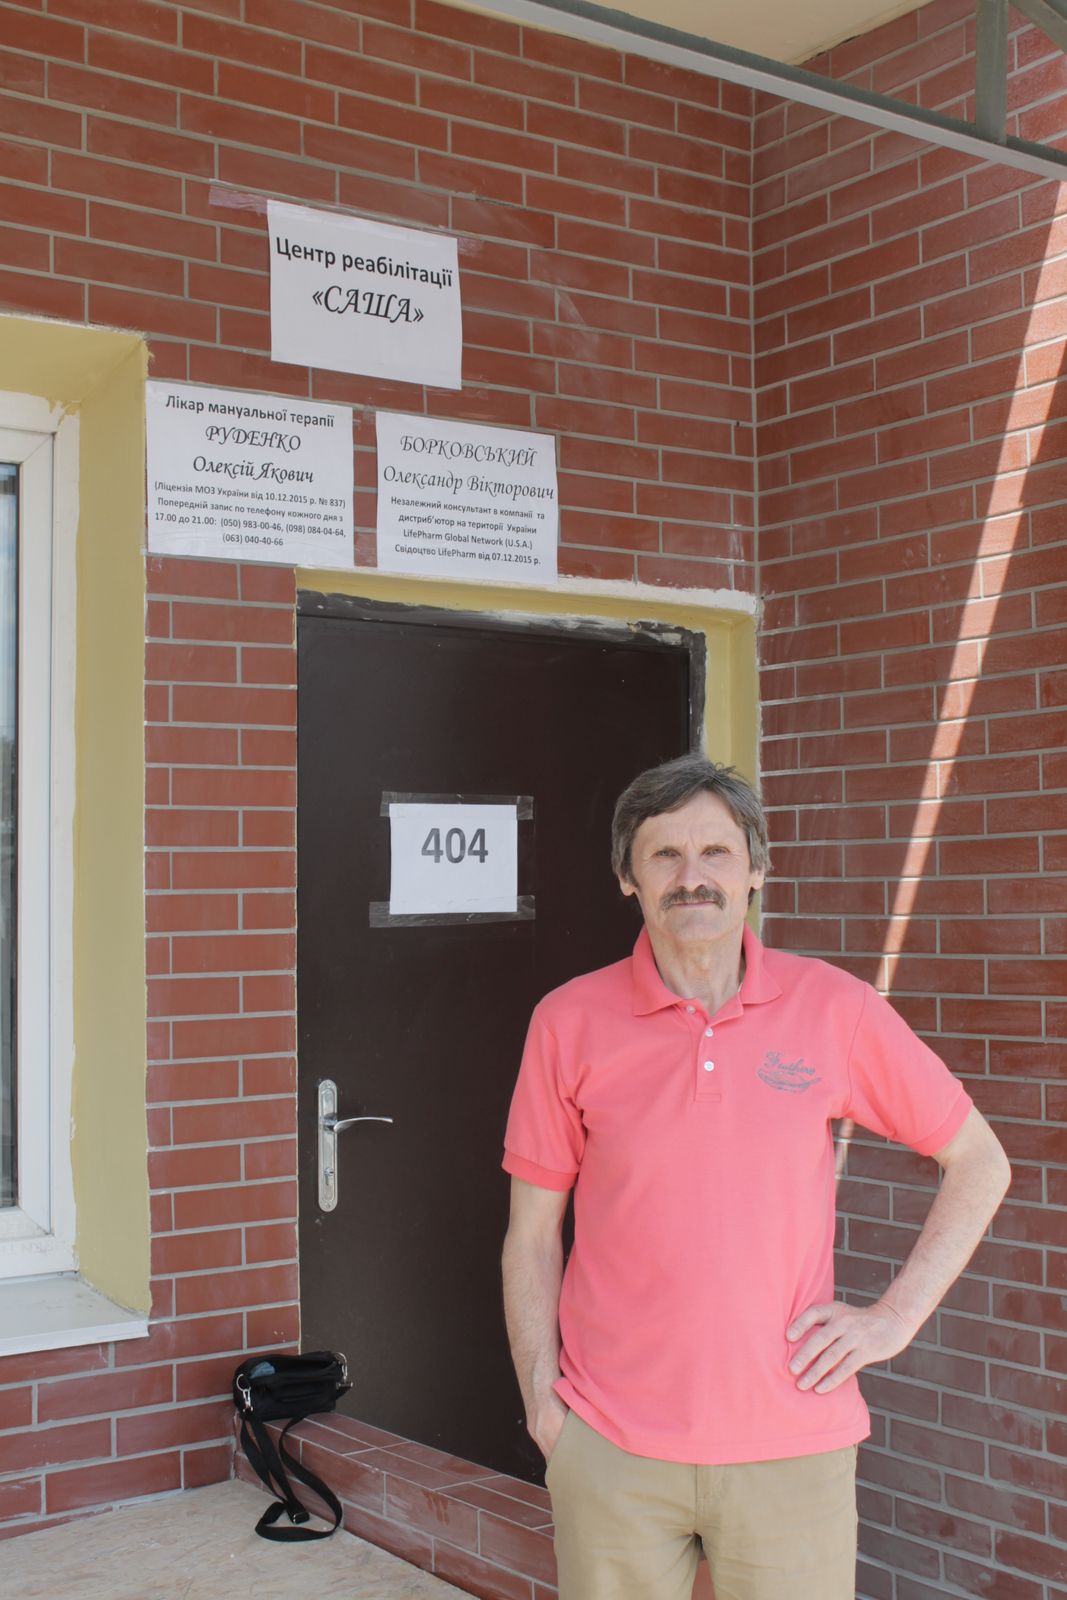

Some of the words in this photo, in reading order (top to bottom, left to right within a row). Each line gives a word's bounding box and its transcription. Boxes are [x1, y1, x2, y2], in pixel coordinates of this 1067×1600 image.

[276, 237, 336, 268] Центр
[342, 252, 452, 289] реабілітації
[312, 285, 424, 323] «САША»
[165, 395, 204, 413] Лікар
[208, 403, 287, 422] мануальної
[290, 412, 335, 427] терапії
[205, 425, 301, 453] РУДЕНКО
[400, 435, 538, 467] БОРКОВСЬКИЙ
[193, 456, 254, 479] Олексій
[254, 462, 314, 484] Якович
[383, 466, 462, 494] Олександр
[466, 475, 554, 501] Вікторович
[154, 481, 193, 494] (Ліцензія
[195, 486, 215, 495] МОЗ
[217, 487, 249, 499] України
[251, 490, 263, 501] від
[265, 492, 307, 504] 10.12.2015
[310, 497, 317, 505] р.
[329, 498, 346, 509] 837)
[391, 496, 442, 509] Незалежний
[443, 502, 491, 515] консультант
[499, 509, 533, 518] компанії
[158, 497, 208, 510] Попередній
[210, 503, 232, 512] запис
[235, 505, 245, 513] по
[247, 507, 285, 518] телефону
[287, 511, 321, 520] кожного
[323, 514, 337, 522] дня
[155, 512, 177, 522] 17.00
[179, 514, 190, 524] до
[192, 515, 217, 526] 21.00:
[220, 518, 241, 528] (050)
[243, 520, 284, 532] 983-00-46,
[285, 523, 306, 534] (098)
[307, 525, 346, 538] 084-04-64,
[403, 529, 442, 540] LifePharm
[445, 533, 469, 543] Global
[471, 536, 504, 546] Network
[505, 538, 533, 549] (U.S.A.)
[468, 521, 503, 531] території
[506, 524, 537, 534] України
[223, 533, 243, 544] (063)
[245, 534, 283, 546] 040-40-66
[395, 544, 436, 556] Свідоцтво
[438, 548, 477, 559] LifePharm
[478, 552, 490, 560] від
[492, 552, 532, 564] 07.12.2015
[533, 557, 541, 565] р.
[421, 827, 489, 864] 404
